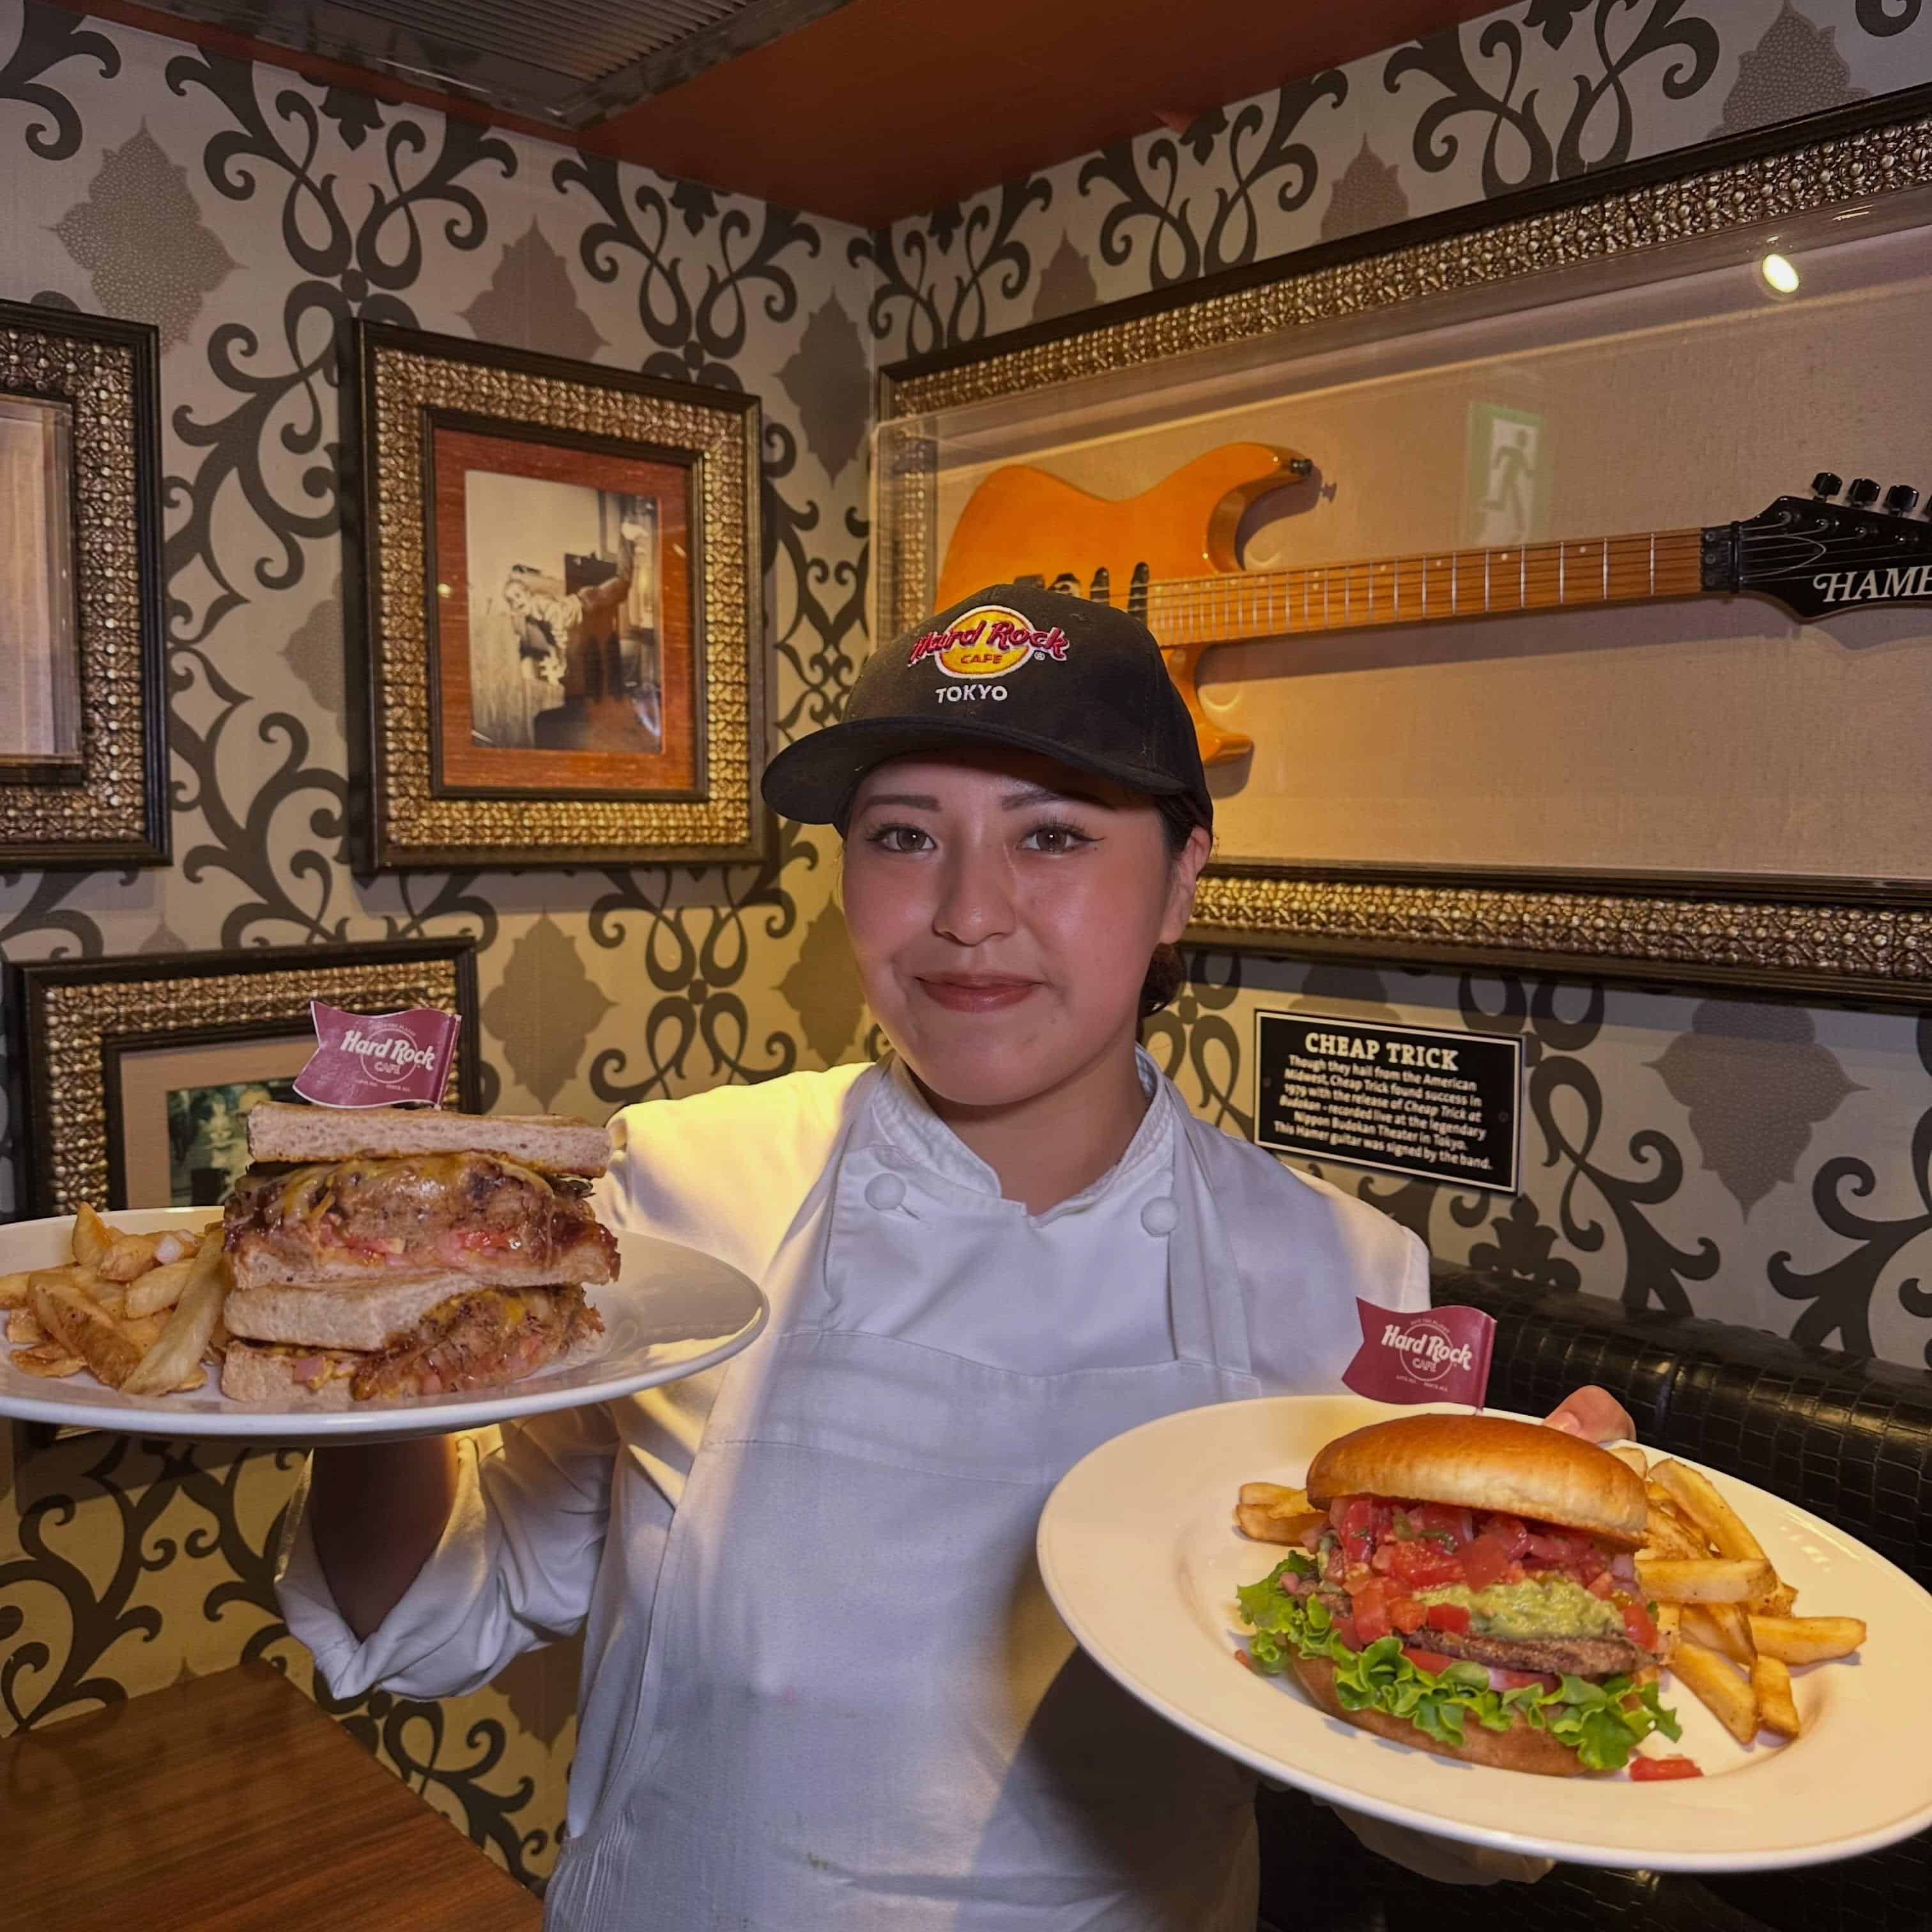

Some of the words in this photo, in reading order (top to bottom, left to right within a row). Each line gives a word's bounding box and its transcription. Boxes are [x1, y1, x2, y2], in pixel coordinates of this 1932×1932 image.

[1813, 565, 1932, 602] HAME
[908, 620, 987, 666] Hard
[986, 620, 1070, 661] Rock
[961, 654, 1002, 664] CAFE
[935, 684, 1008, 703] TOKYO
[340, 1029, 394, 1058] Hard
[390, 1039, 435, 1071] Rock
[1305, 1032, 1380, 1060] CHEAP
[1385, 1041, 1459, 1071] TRICK
[1289, 1055, 1326, 1073] Though
[1328, 1061, 1351, 1077] they
[1353, 1063, 1372, 1076] hail
[1374, 1066, 1400, 1080] from
[1402, 1071, 1422, 1084] the
[1423, 1074, 1476, 1091] American
[1329, 1075, 1363, 1091] Cheap
[1364, 1079, 1389, 1094] Trick
[1390, 1083, 1423, 1098] found
[1424, 1091, 1468, 1106] success
[1470, 1095, 1482, 1106] in
[1280, 1095, 1321, 1110] Budokan
[1328, 1105, 1372, 1120] recorded
[1374, 1110, 1393, 1123] live
[1394, 1115, 1406, 1125] at
[1408, 1116, 1427, 1129] the
[1429, 1118, 1486, 1142] legendary
[1308, 1087, 1331, 1099] with
[1333, 1090, 1351, 1102] the
[1352, 1093, 1389, 1108] release
[1390, 1098, 1403, 1109] of
[1404, 1100, 1439, 1118] Cheap
[1441, 1105, 1466, 1119] Trick
[1468, 1112, 1482, 1122] at
[1274, 1120, 1294, 1135] This
[1296, 1125, 1329, 1140] Hamer
[1330, 1131, 1361, 1148] guitar
[1363, 1139, 1384, 1151] was
[1386, 1142, 1422, 1160] signed
[1423, 1147, 1438, 1163] by
[1439, 1151, 1459, 1163] the
[1460, 1153, 1492, 1170] band.
[1294, 1110, 1330, 1128] Nippon
[1332, 1117, 1376, 1134] Budokan
[1378, 1124, 1418, 1141] Theater
[1420, 1132, 1431, 1143] in
[1381, 1324, 1428, 1354] Hard
[1425, 1335, 1472, 1370] Rock
